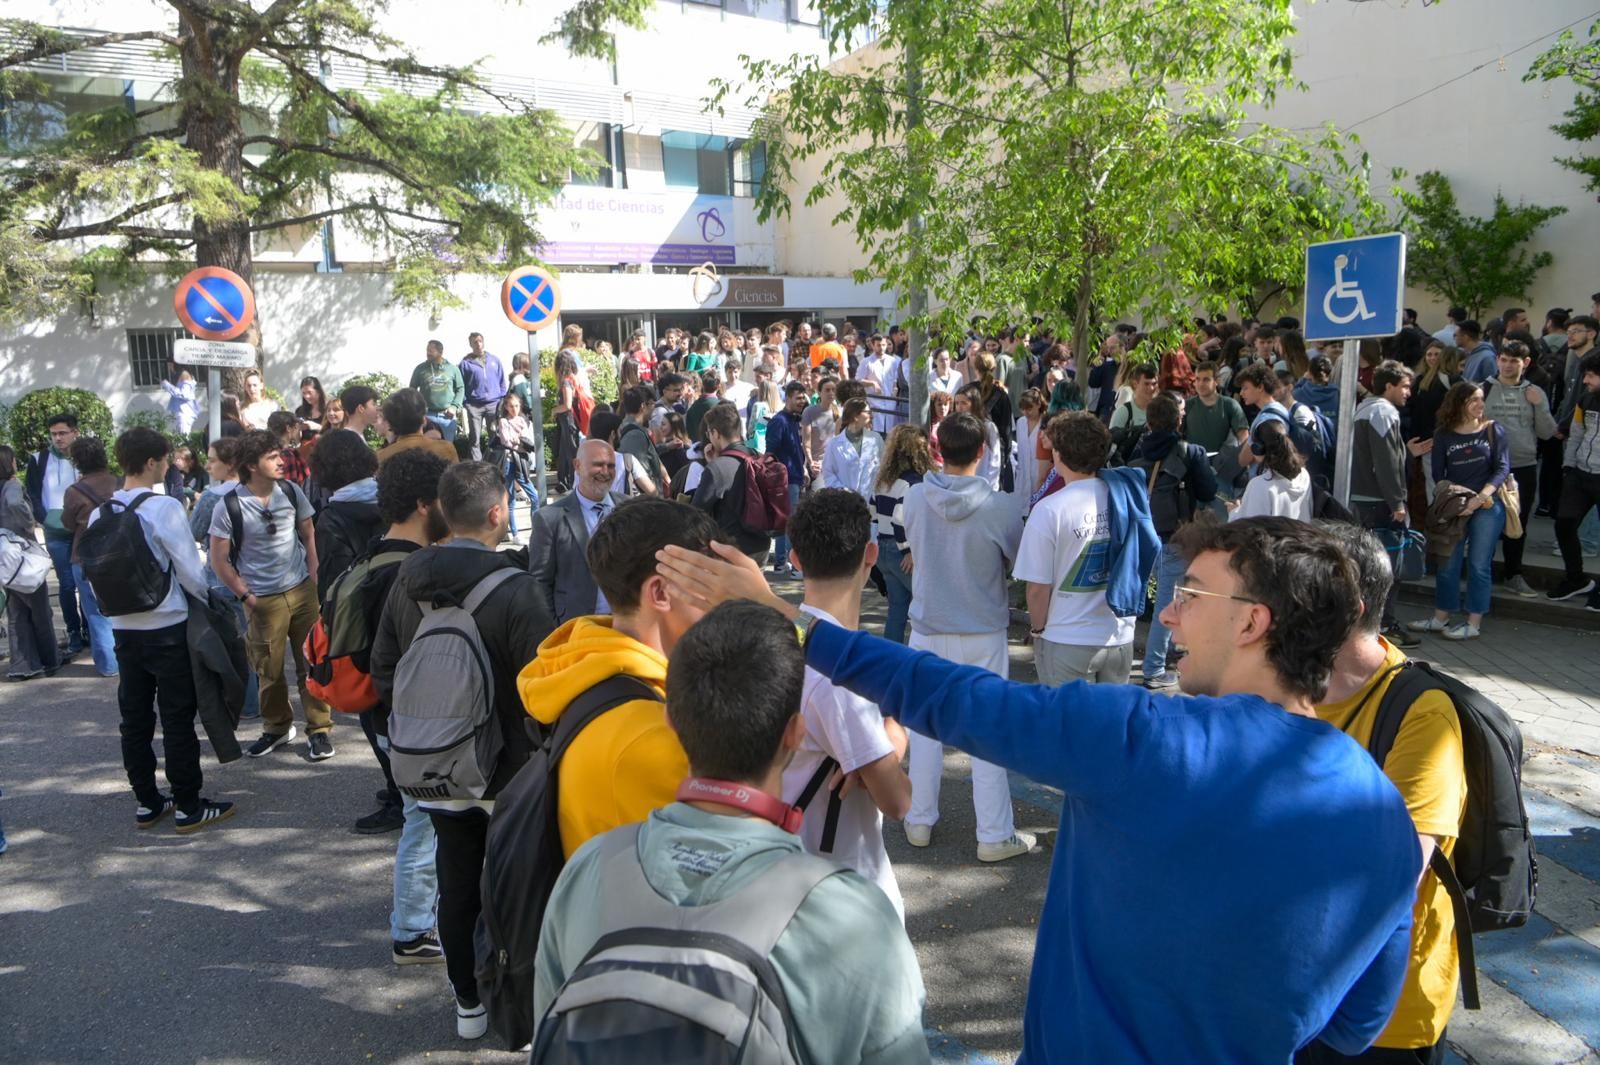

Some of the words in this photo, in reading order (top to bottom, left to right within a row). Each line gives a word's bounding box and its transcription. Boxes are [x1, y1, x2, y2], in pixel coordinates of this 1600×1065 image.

[587, 197, 604, 212] de
[608, 199, 665, 215] Ciencias
[734, 288, 778, 304] Ciencias
[688, 780, 735, 796] Pioneer
